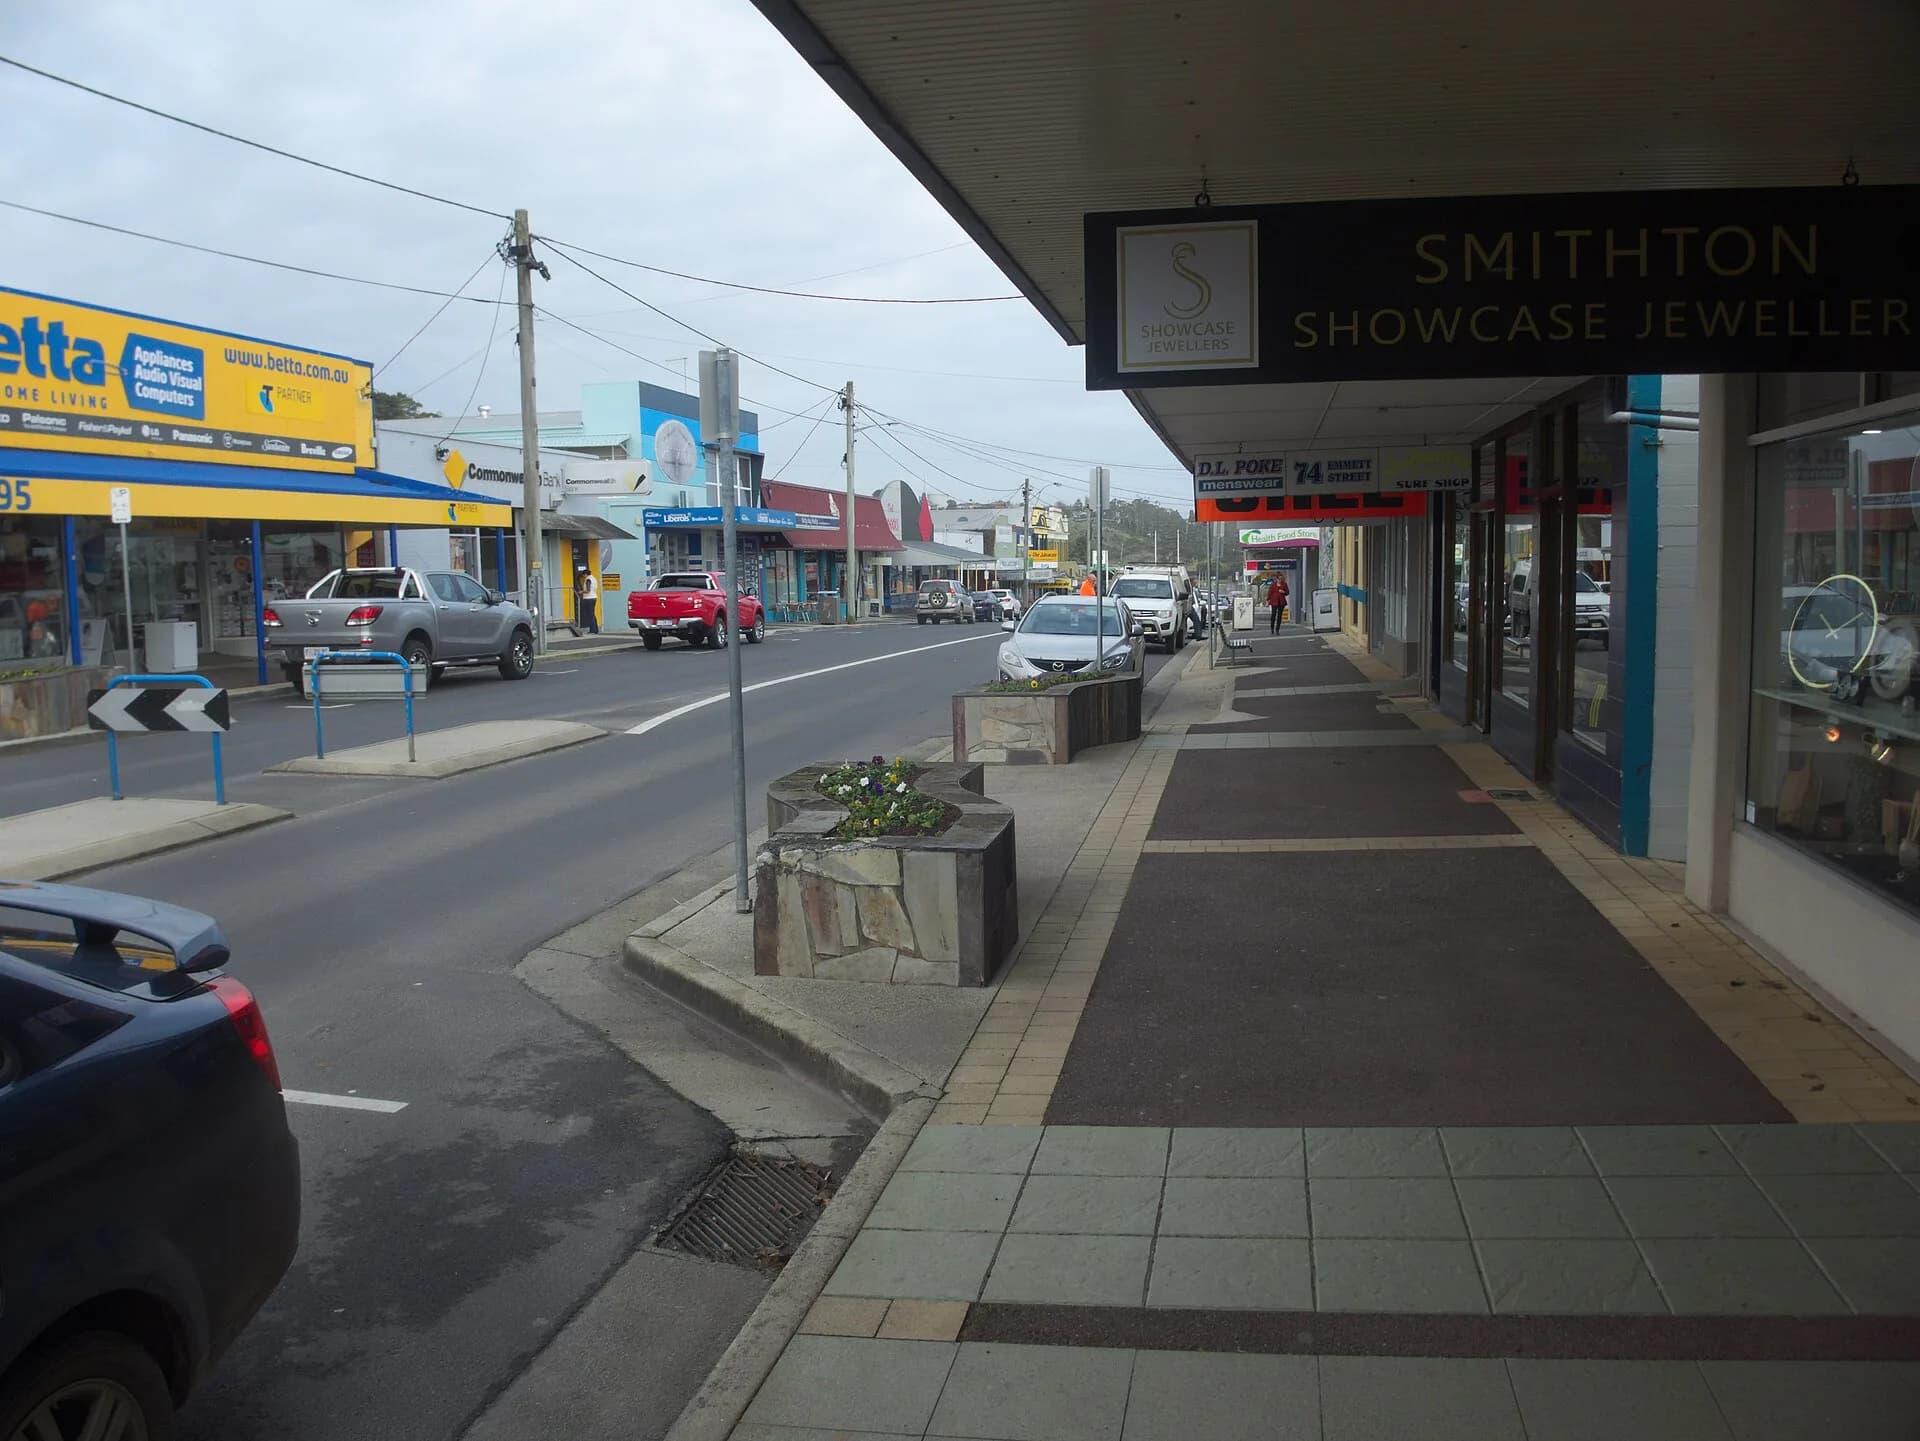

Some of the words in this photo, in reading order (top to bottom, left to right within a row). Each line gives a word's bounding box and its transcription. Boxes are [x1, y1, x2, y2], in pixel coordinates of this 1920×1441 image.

[1415, 224, 1818, 284] SMITHTON
[1141, 320, 1235, 338] SHOWCASE
[1293, 303, 1608, 348] SHOWCASE
[1146, 338, 1230, 353] JEWELLERS
[134, 345, 195, 373] Appliances
[224, 346, 349, 384] www.betta.com.au
[134, 363, 168, 384] Audio
[168, 370, 203, 392] Visual
[51, 389, 108, 410] LIVING
[134, 381, 195, 407] Computers
[276, 385, 312, 404] PARTNER
[1199, 460, 1229, 477] D.L.
[1234, 458, 1284, 475] POKE
[1294, 460, 1324, 486] 74
[1327, 458, 1372, 471] EMMETT
[1202, 479, 1280, 491] menswear
[1327, 471, 1372, 483] STREET
[1395, 478, 1429, 489] SURF
[1434, 477, 1470, 488] SHOP
[1251, 532, 1276, 543] Health
[1277, 530, 1296, 541] Food
[1297, 528, 1319, 539] Store
